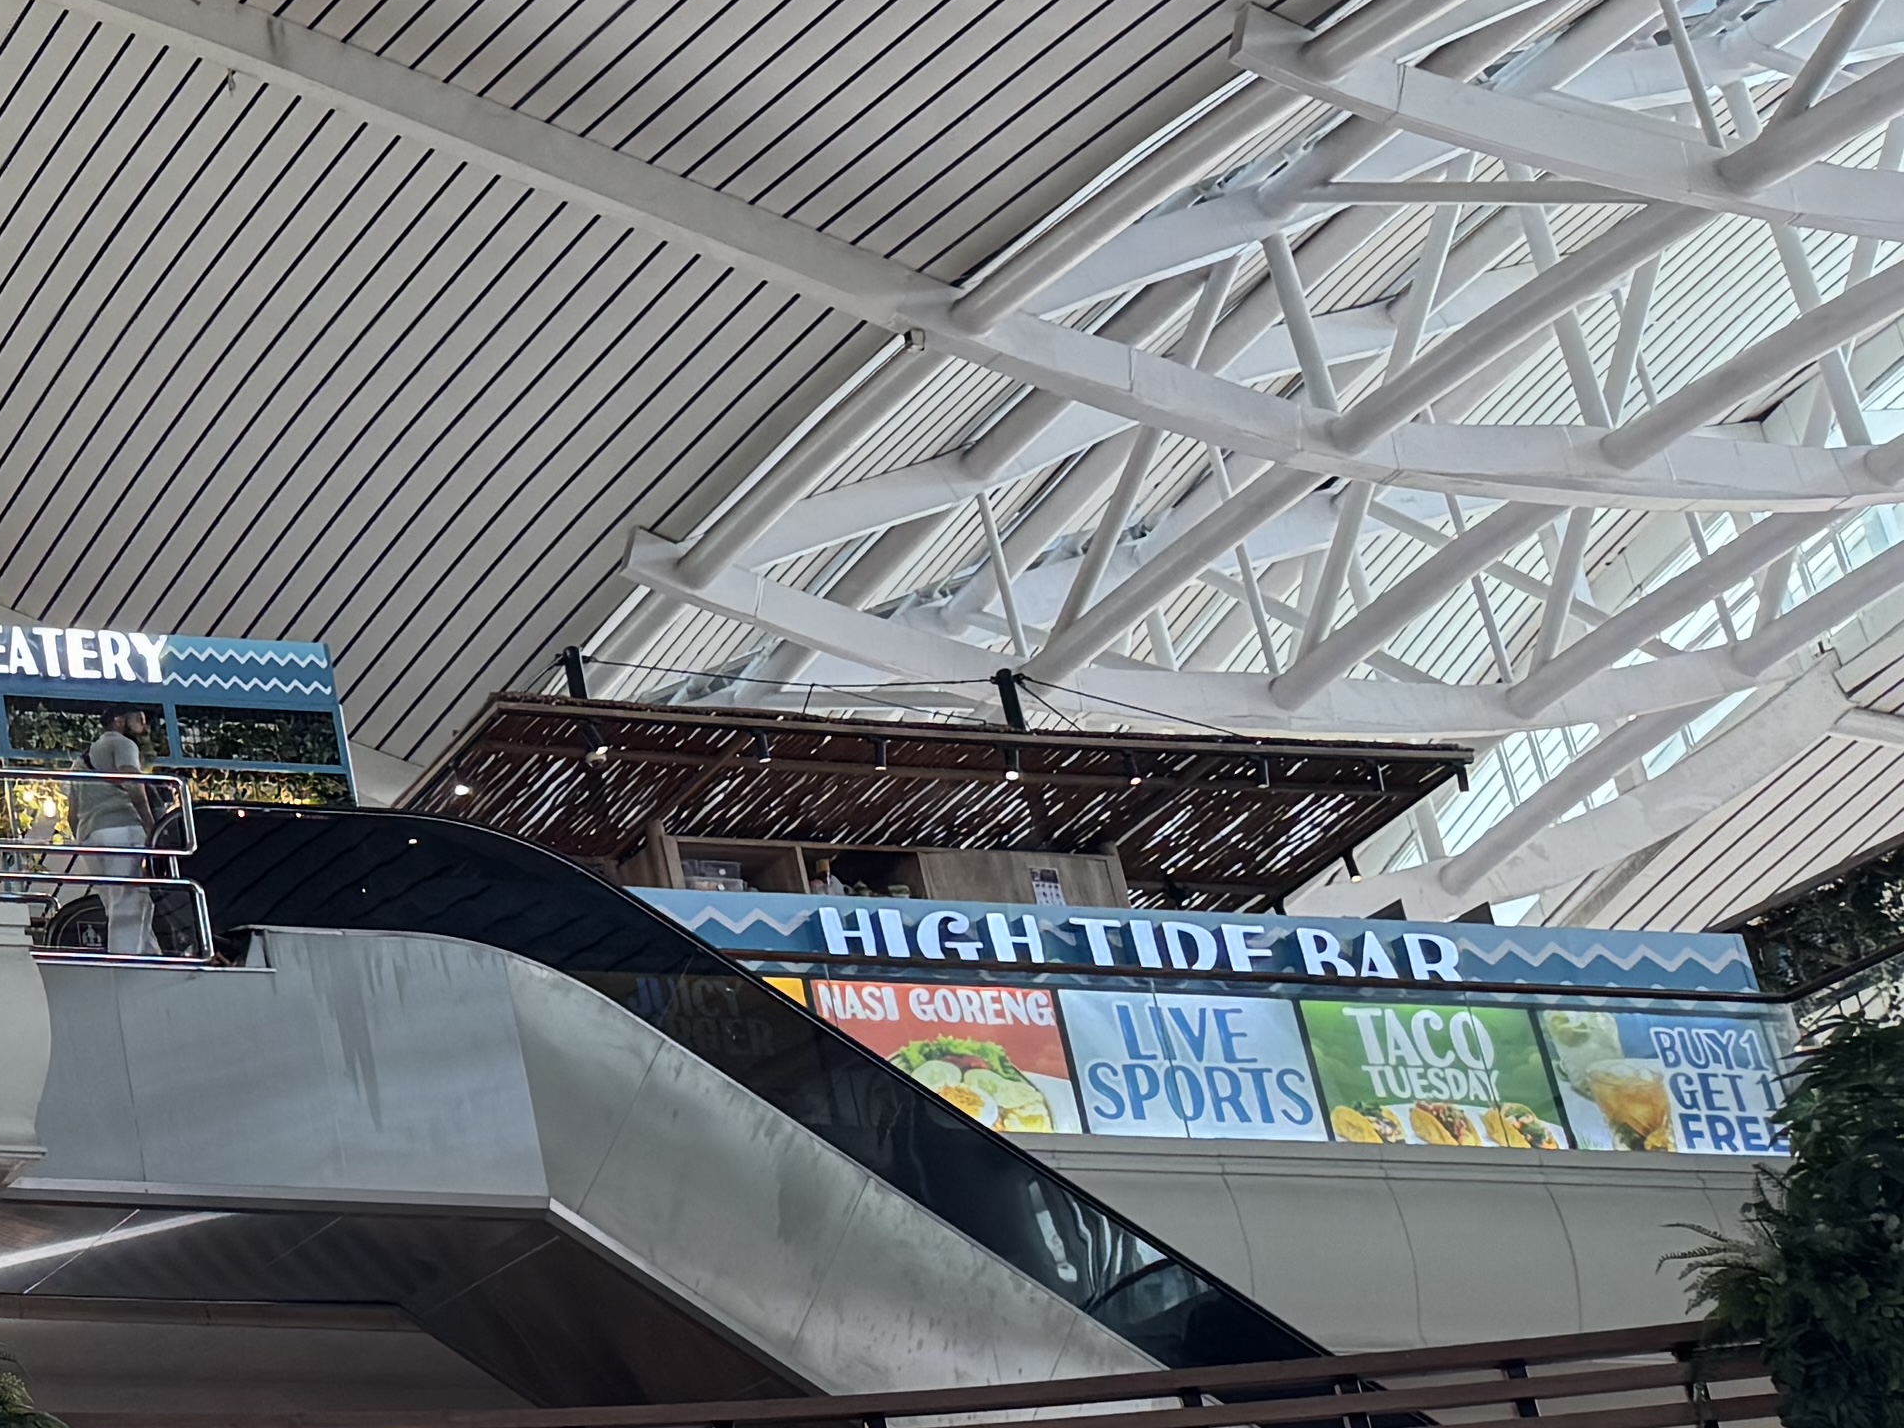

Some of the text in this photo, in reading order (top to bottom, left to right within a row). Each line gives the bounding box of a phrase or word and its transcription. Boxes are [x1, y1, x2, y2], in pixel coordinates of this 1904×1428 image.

[817, 906, 1463, 983] HIGH TIDE BAR
[818, 981, 1057, 1029] NASI GORENG
[1114, 1002, 1259, 1065] LIVE
[1341, 1006, 1495, 1070] TACO
[1650, 1025, 1770, 1072] BUY 1
[1084, 1059, 1314, 1127] SPORTS
[1361, 1063, 1501, 1104] TUESDAY
[1668, 1071, 1778, 1113] GET 1
